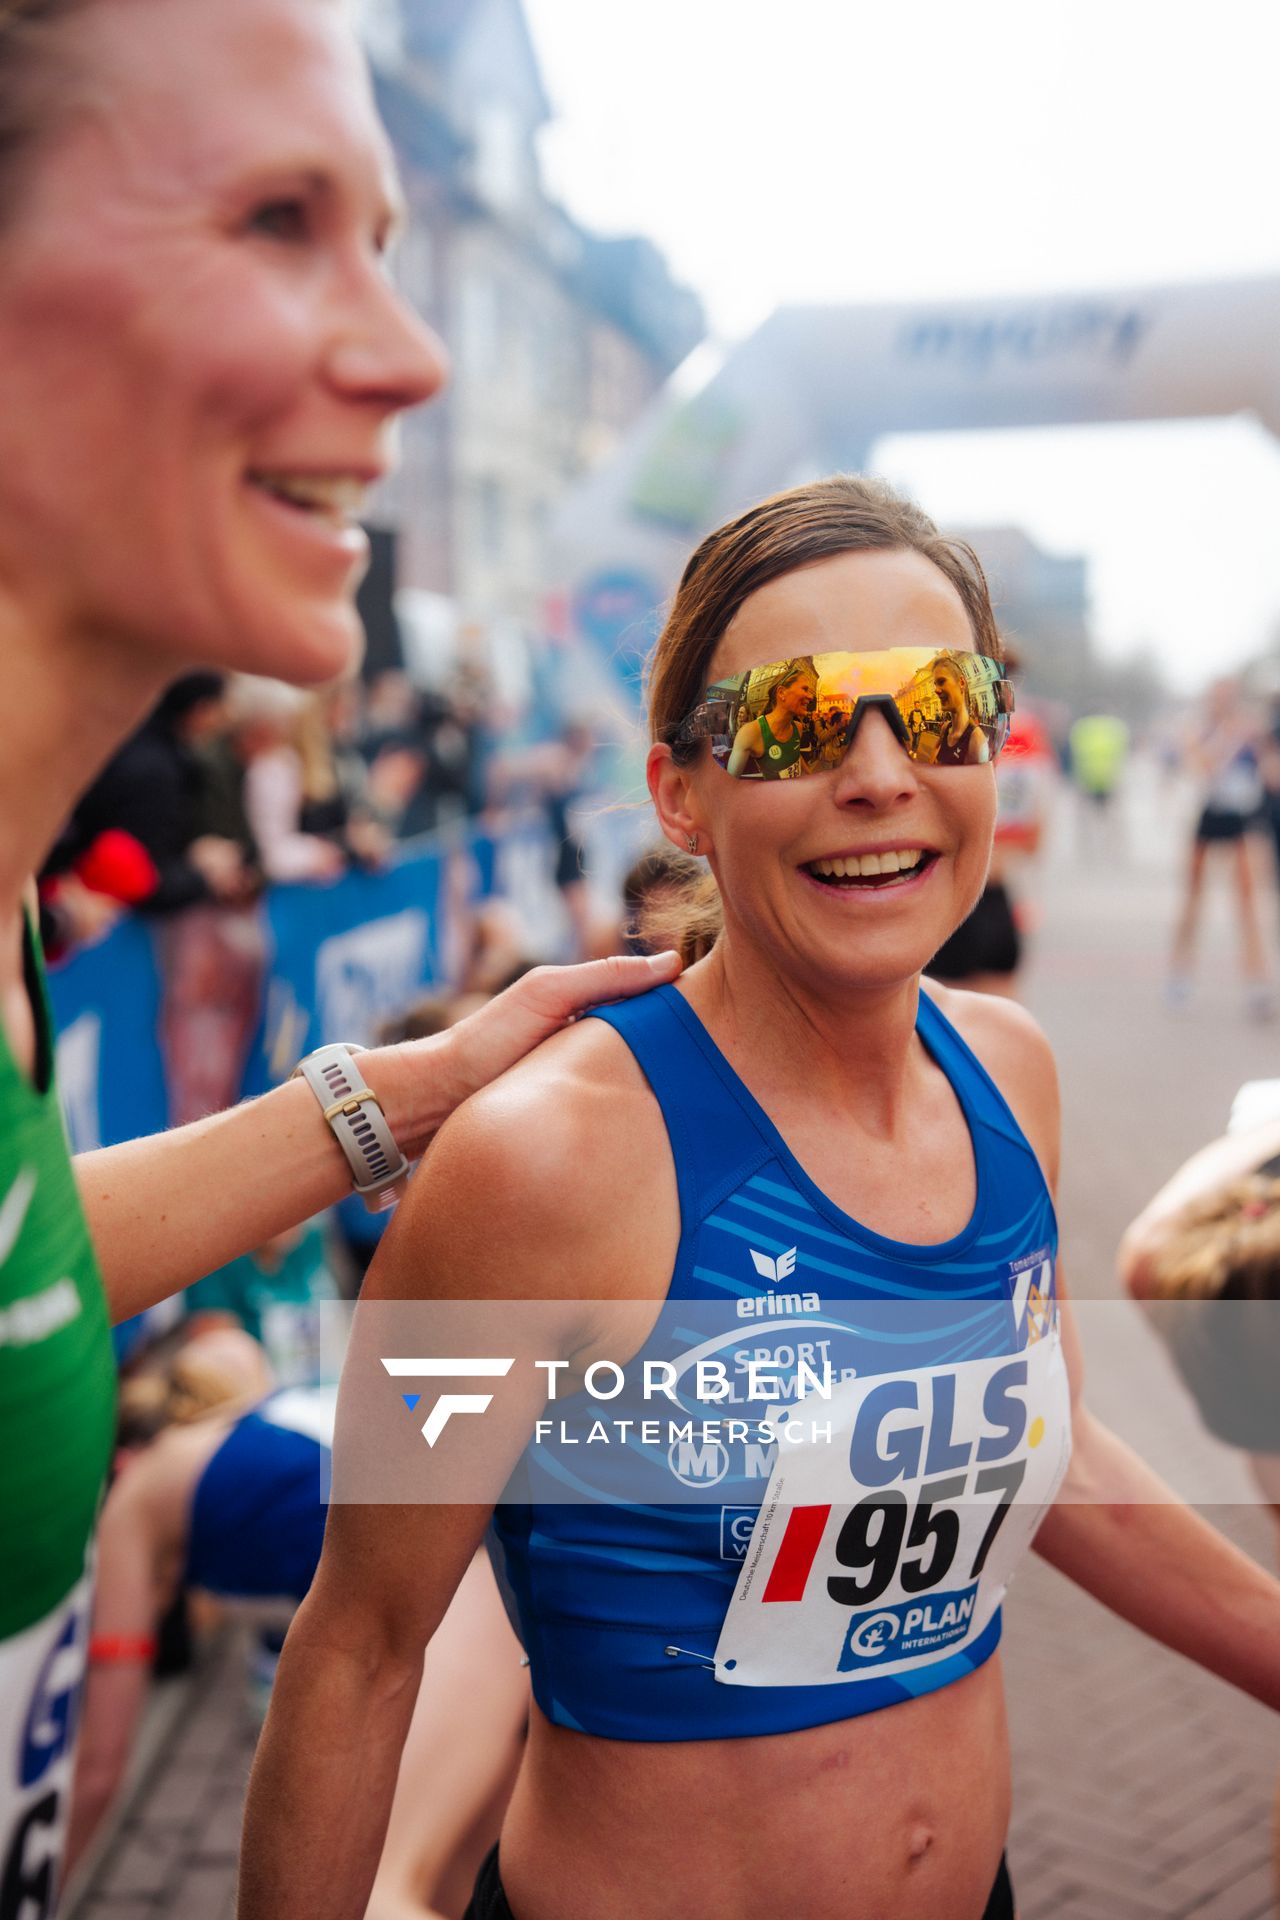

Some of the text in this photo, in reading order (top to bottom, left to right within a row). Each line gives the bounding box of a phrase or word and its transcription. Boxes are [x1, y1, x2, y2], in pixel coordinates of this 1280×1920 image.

[736, 1290, 820, 1318] erima
[733, 1340, 831, 1374] SPORT
[849, 1360, 1028, 1488] GLS
[739, 1568, 756, 1601] Deutsche
[750, 1522, 771, 1569] Meisterschaft
[826, 1458, 1028, 1607] 957
[903, 1593, 976, 1635] PLAN
